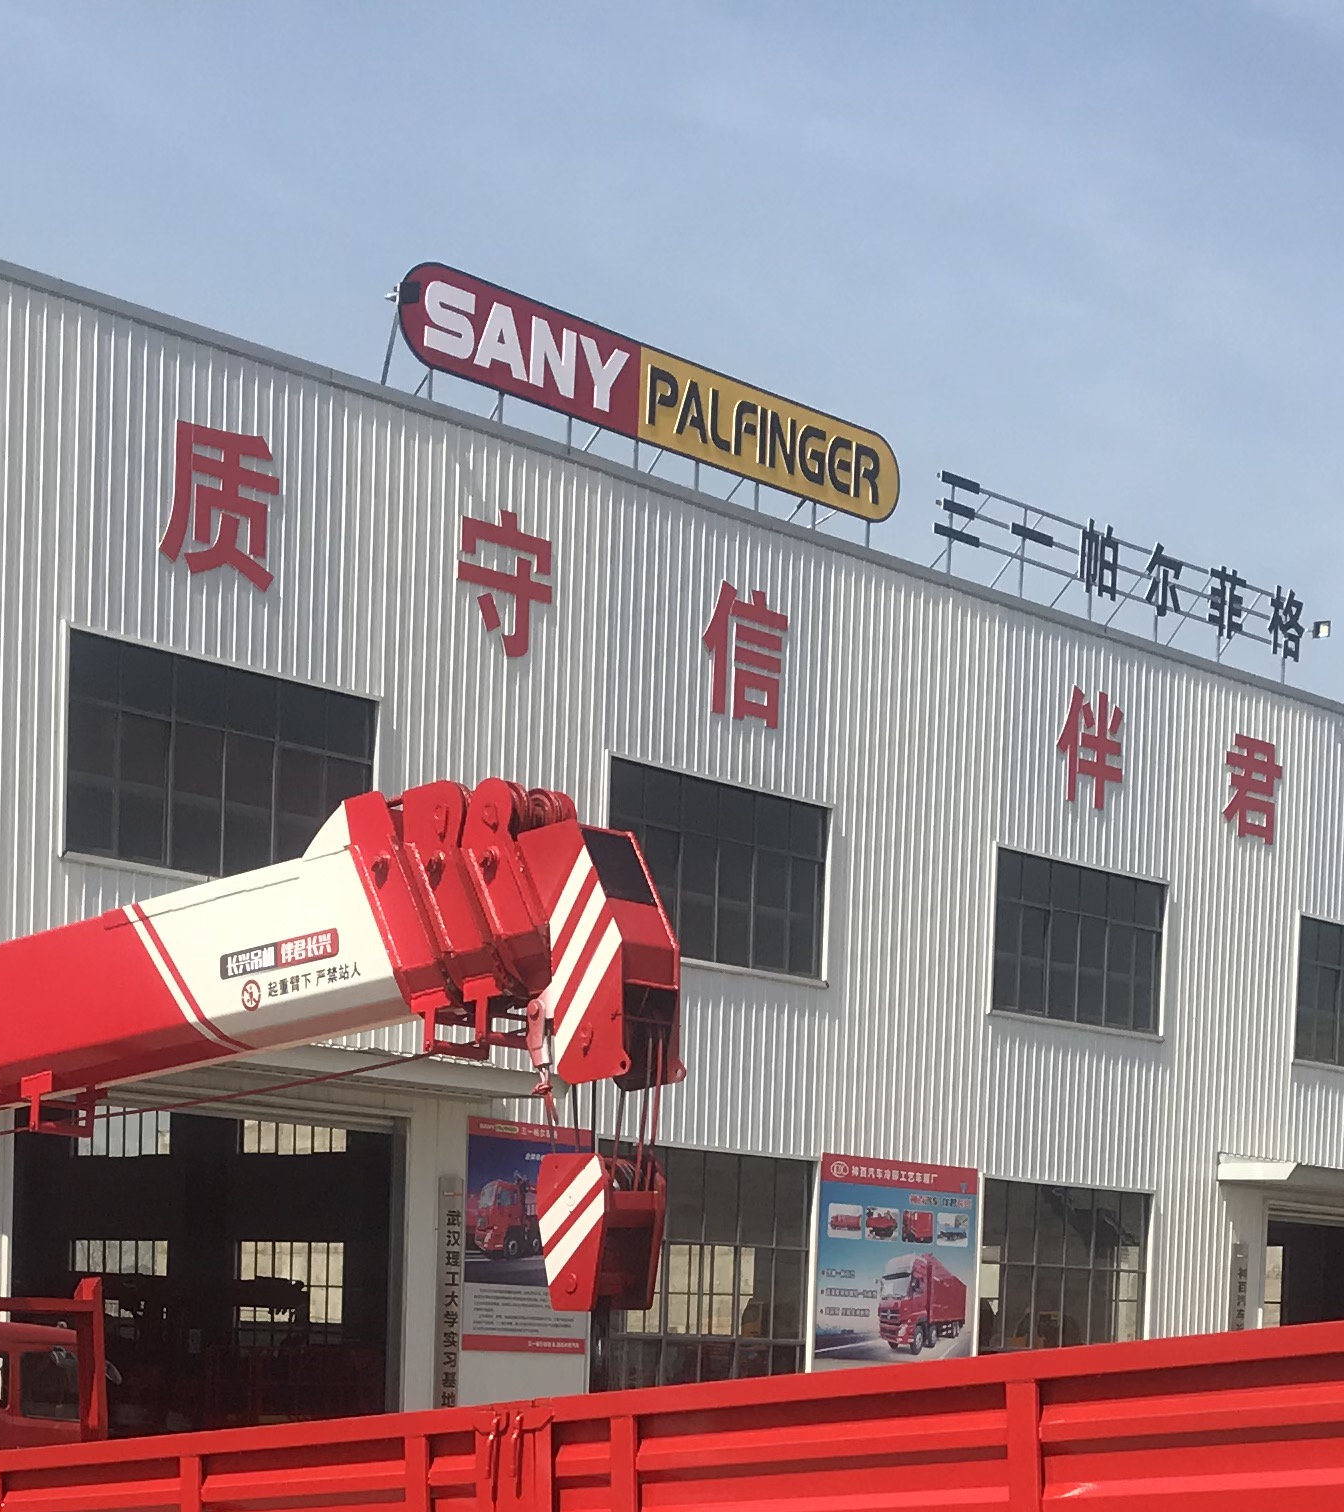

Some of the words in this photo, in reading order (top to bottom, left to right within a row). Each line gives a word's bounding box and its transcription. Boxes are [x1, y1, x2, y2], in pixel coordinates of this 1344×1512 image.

[424, 280, 630, 413] SANY
[645, 363, 880, 506] PALFINGER
[933, 469, 1304, 662] 三一帕尔菲格
[226, 946, 276, 977] 长兴吊机
[280, 932, 332, 964] 伴君长兴
[267, 972, 312, 998] 起重臂下
[315, 961, 361, 987] 严禁站人
[441, 1209, 461, 1408] 武汉理工大学实习基地
